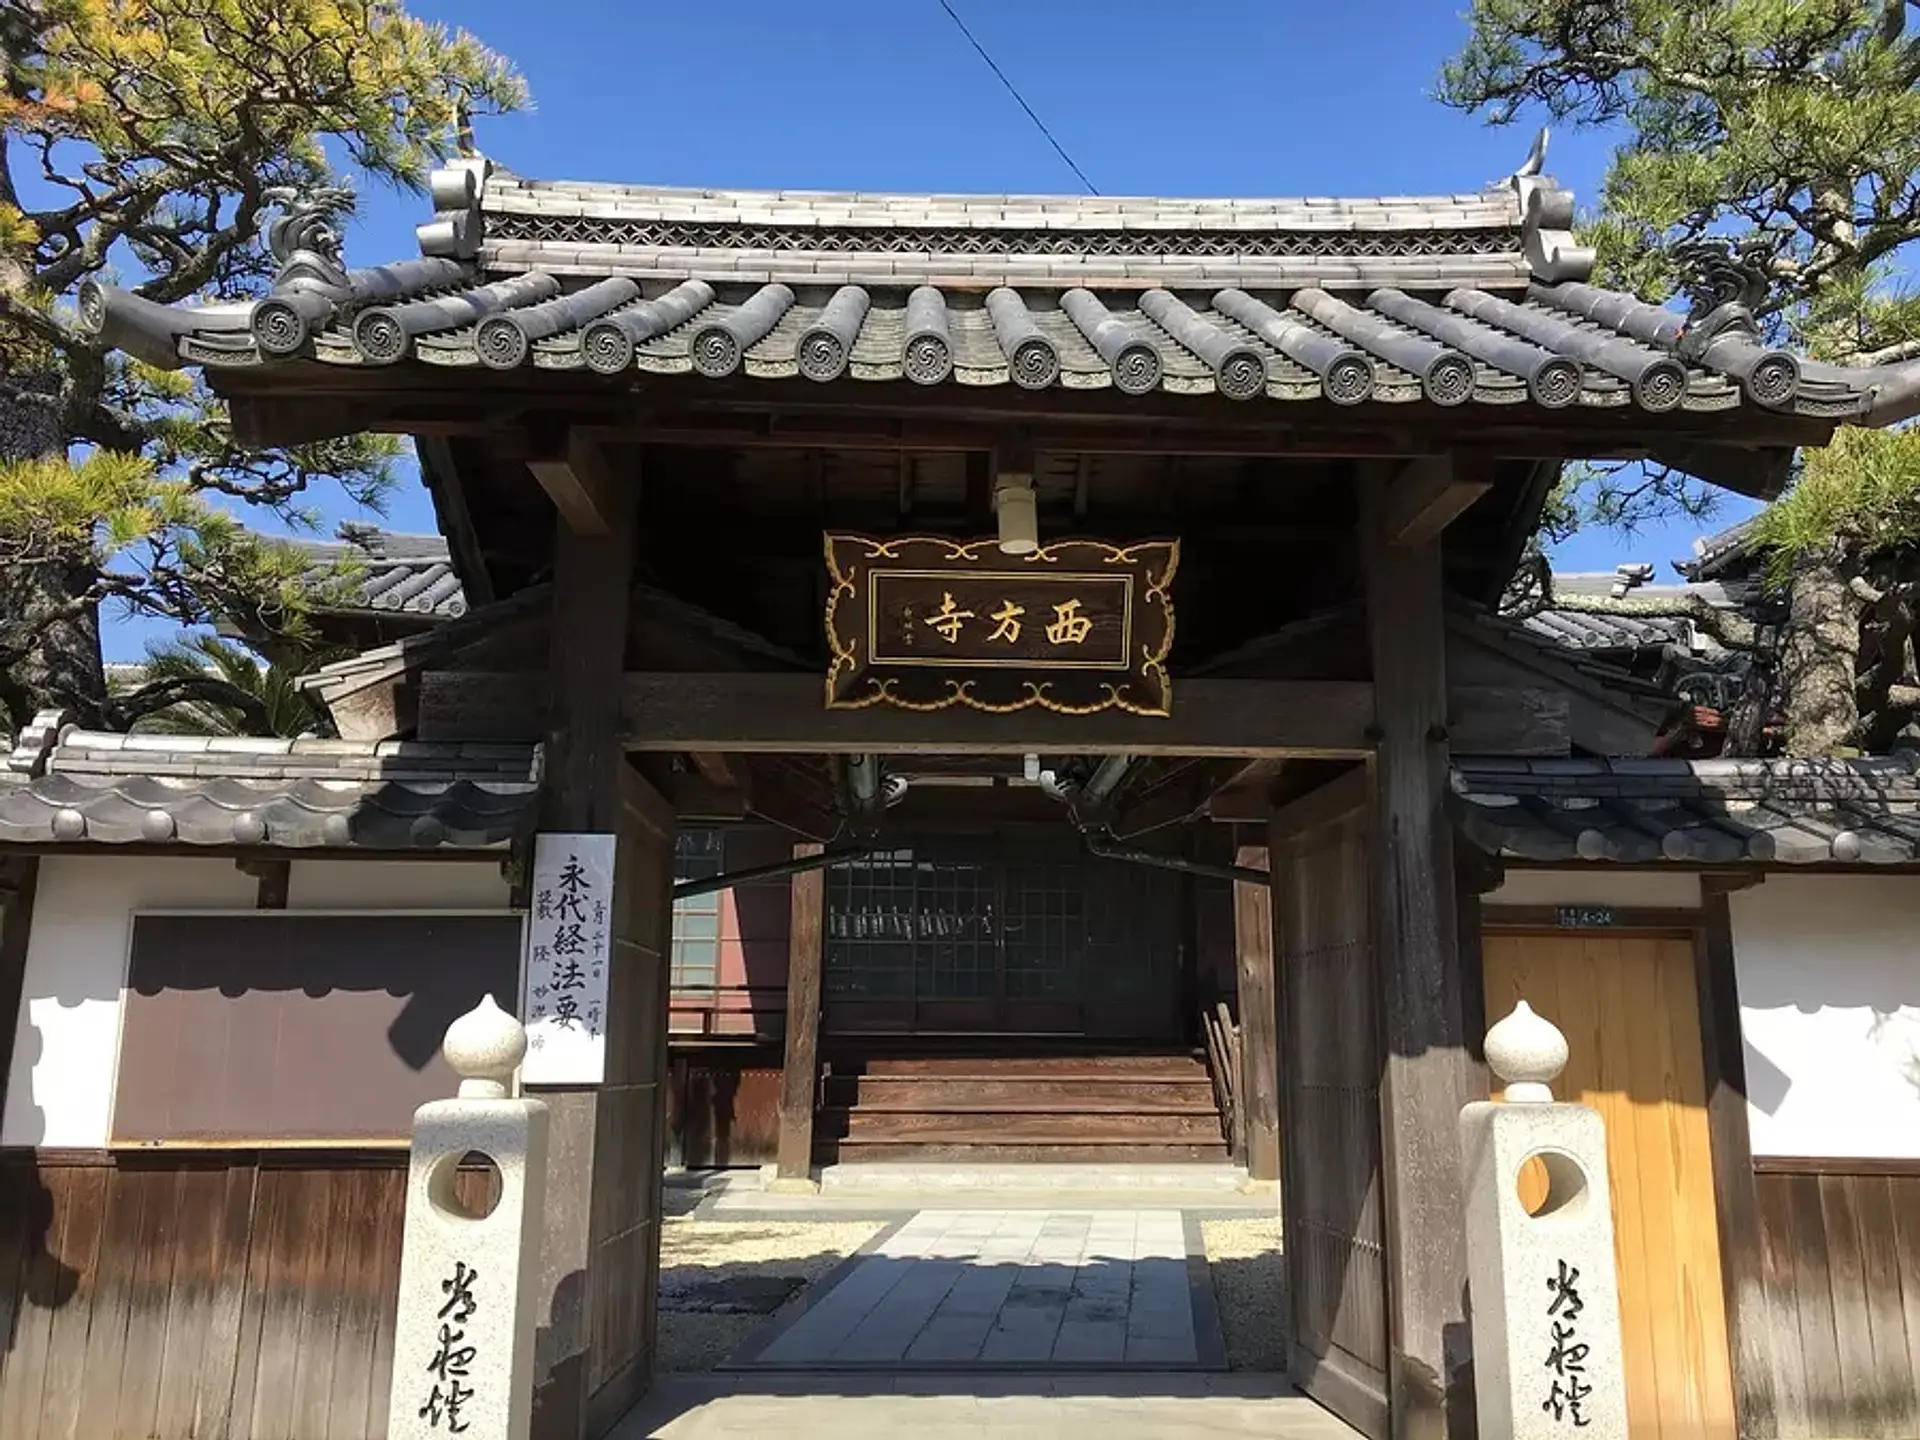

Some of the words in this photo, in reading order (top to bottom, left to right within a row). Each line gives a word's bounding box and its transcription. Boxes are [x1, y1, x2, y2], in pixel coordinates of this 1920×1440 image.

[924, 591, 1094, 645] 西方寺
[550, 853, 592, 1032] 永代経法要
